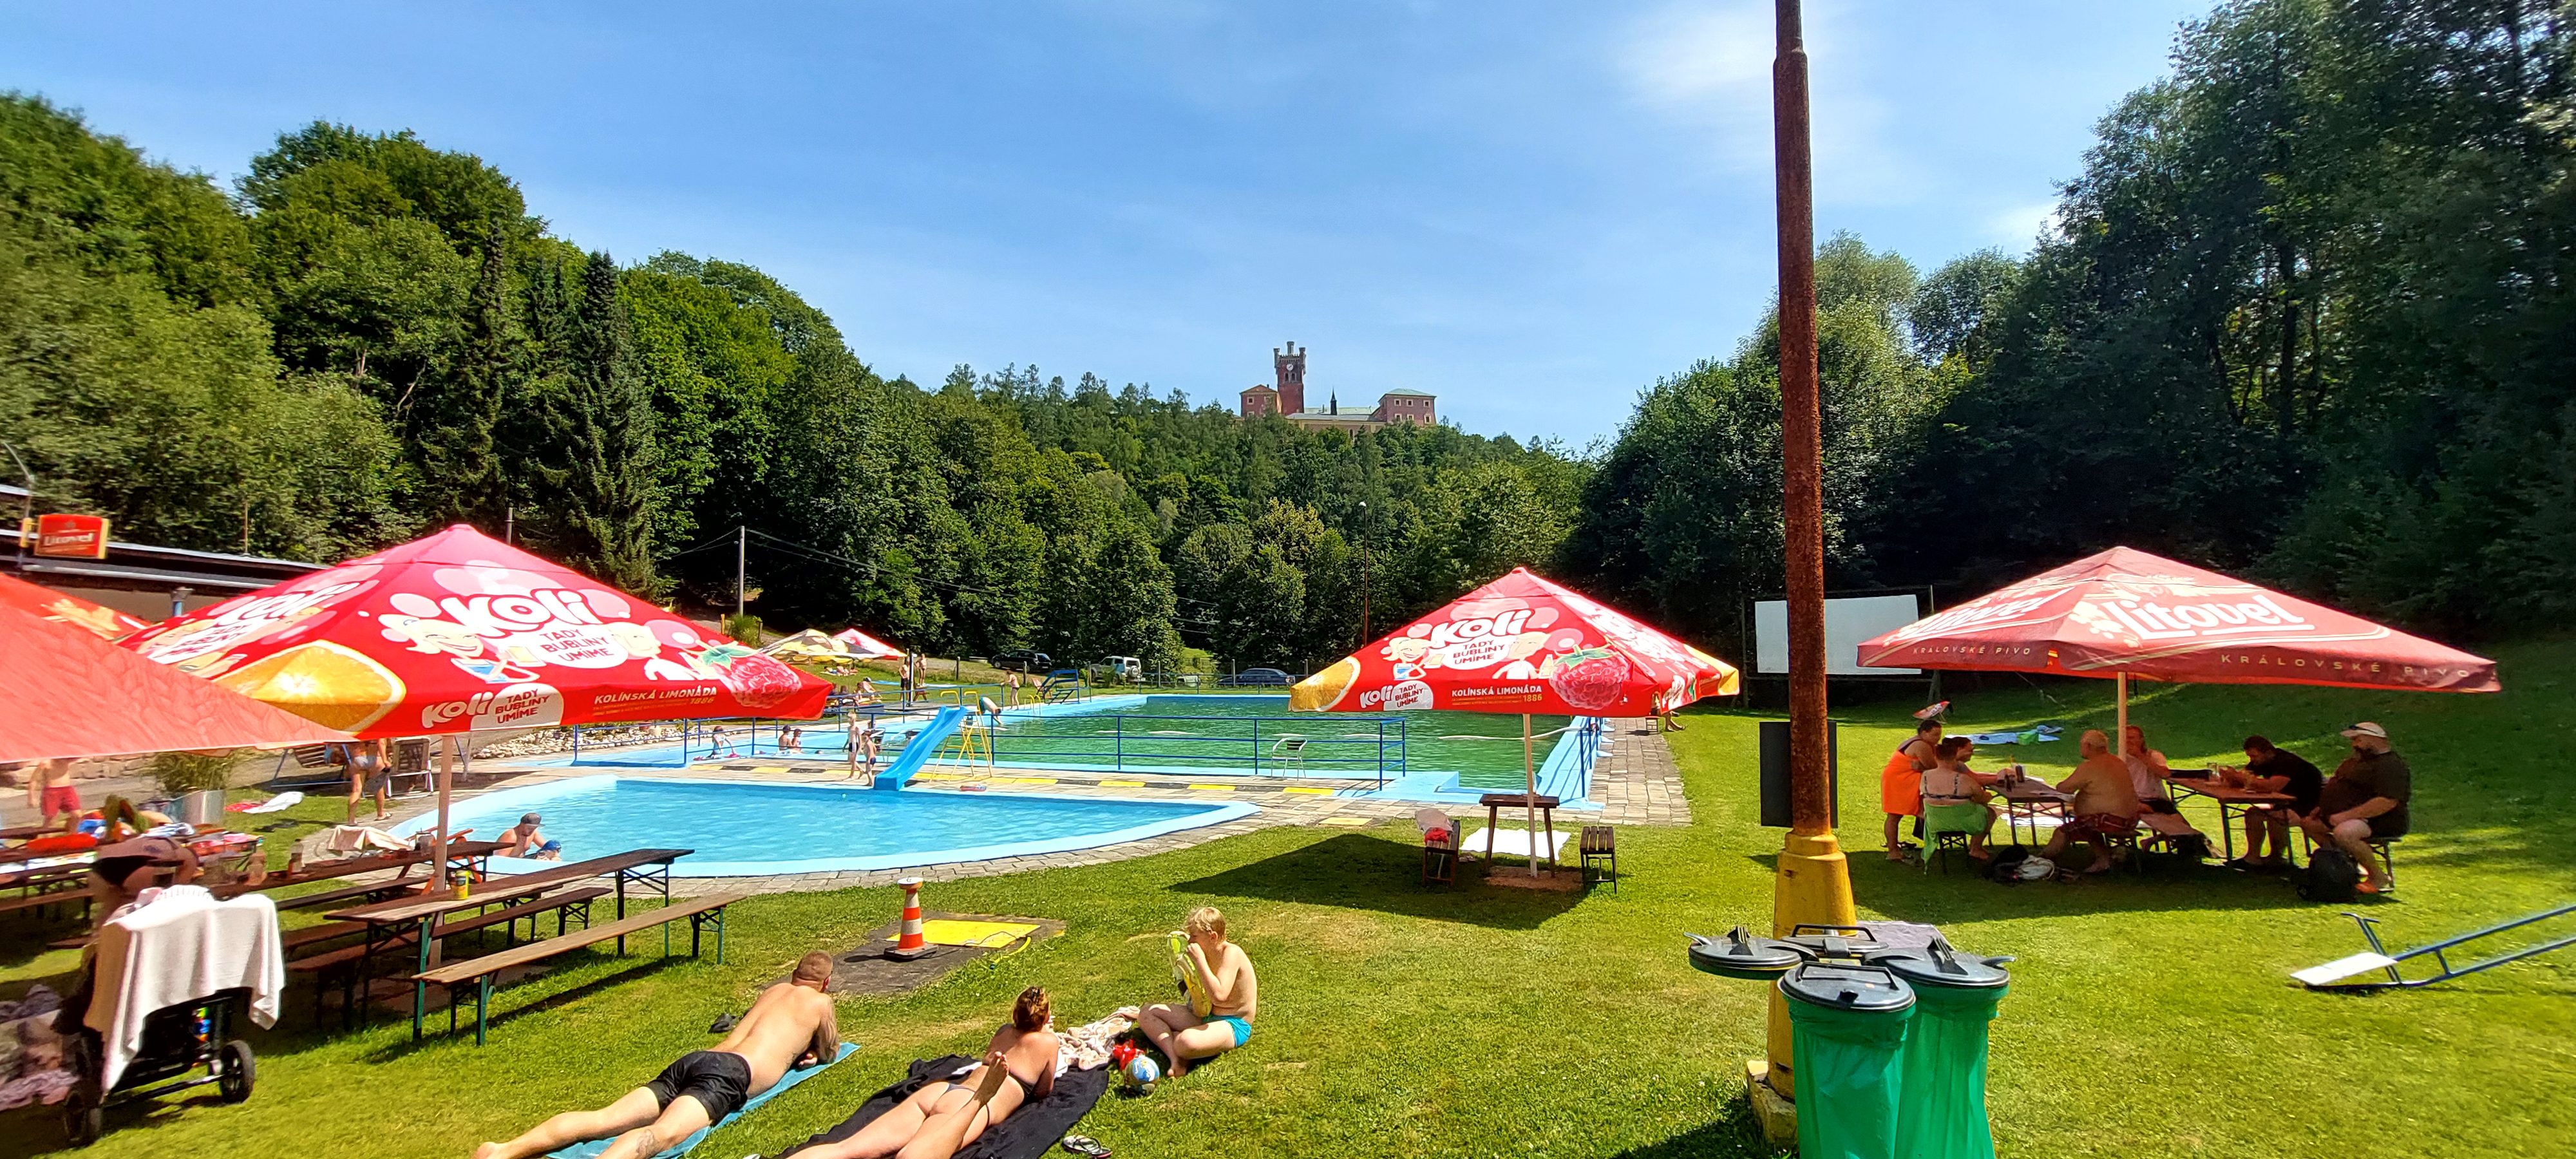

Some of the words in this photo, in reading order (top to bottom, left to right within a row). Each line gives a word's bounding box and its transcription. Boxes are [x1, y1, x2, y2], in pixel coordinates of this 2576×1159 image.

[440, 589, 604, 637] Koli
[2100, 594, 2306, 640] Litovel
[539, 628, 584, 641] TADY
[1428, 609, 1532, 649] Koli
[540, 636, 611, 653] BUBLINY
[1453, 644, 1506, 659] BUBLINY
[1463, 639, 1494, 650] TADY
[1996, 647, 2031, 655] PIVO
[558, 647, 614, 661] UMÍME
[1454, 653, 1495, 664] UMÍME
[2221, 654, 2380, 672] KRÁLOVSKÉ
[2404, 666, 2469, 678] PIVO
[507, 688, 538, 703] TADY
[594, 689, 657, 704] KOLÍNSKÁ
[659, 685, 717, 699] LIMONÁDA
[1395, 688, 1423, 701] BUBLINY
[1399, 683, 1417, 693] TADY
[1452, 686, 1495, 697] KOLÍNSKÁ
[1497, 684, 1542, 695] LIMONÁDA
[495, 694, 550, 714] BUBLINY
[1359, 685, 1393, 708] Koli
[1396, 696, 1419, 708] UMÍME
[1522, 693, 1542, 702] 1886
[422, 691, 494, 728] Koli
[497, 706, 539, 724] UMÍME
